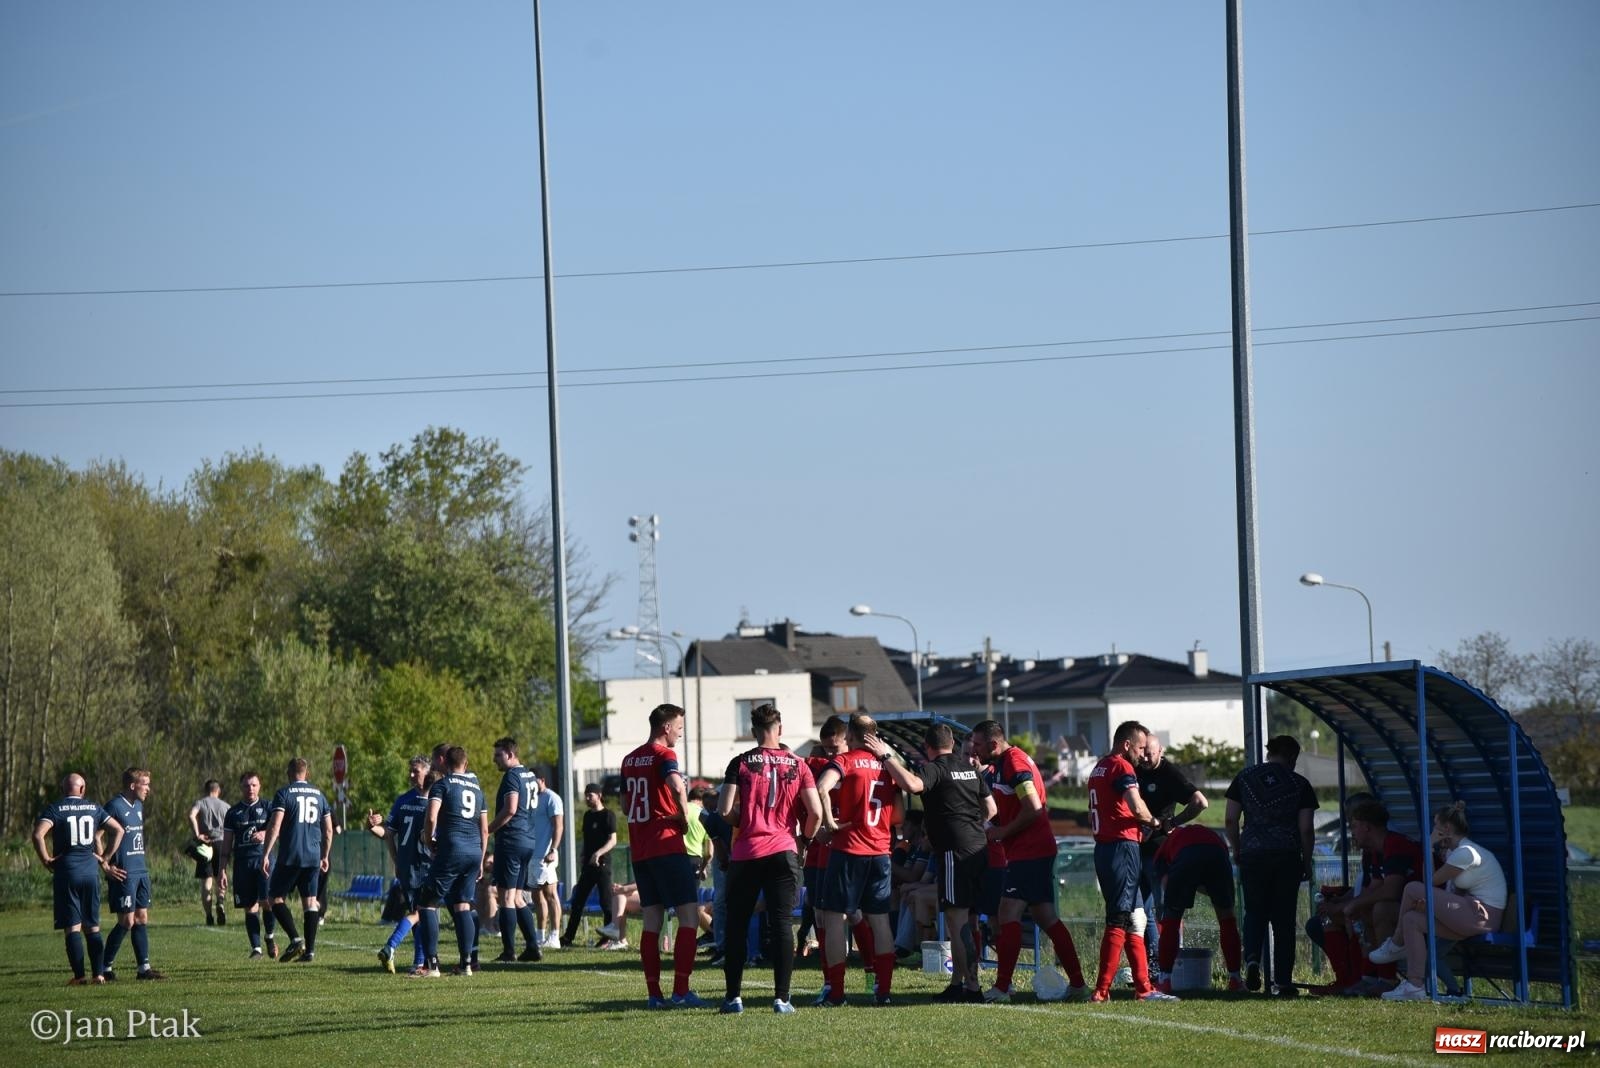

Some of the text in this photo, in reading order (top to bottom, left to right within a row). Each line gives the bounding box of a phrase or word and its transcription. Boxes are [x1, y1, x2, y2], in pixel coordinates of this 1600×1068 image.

[748, 754, 763, 763] LKS
[855, 758, 870, 769] LKS
[525, 780, 539, 810] 13
[626, 777, 650, 824] 23
[766, 767, 777, 808] 1
[296, 795, 318, 824] 16
[461, 789, 476, 819] 9
[867, 780, 885, 827] 5
[66, 815, 94, 846] 10
[401, 815, 414, 846] 7
